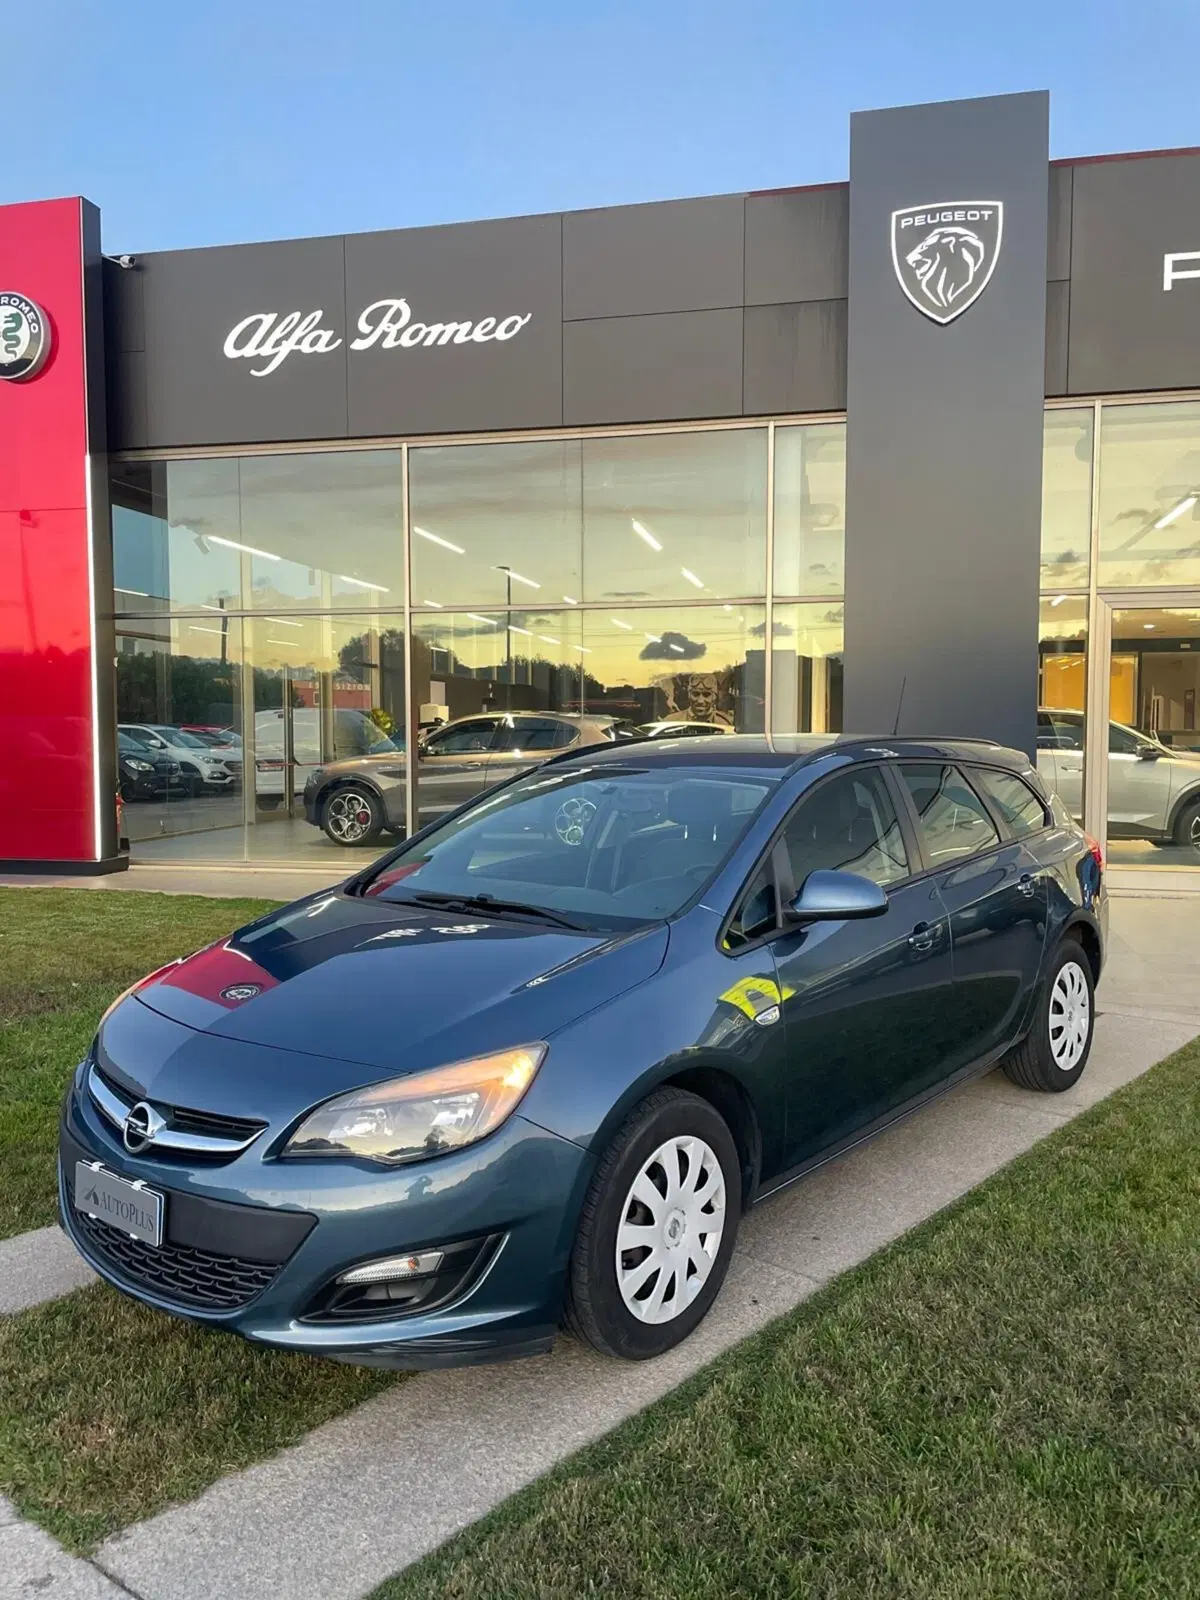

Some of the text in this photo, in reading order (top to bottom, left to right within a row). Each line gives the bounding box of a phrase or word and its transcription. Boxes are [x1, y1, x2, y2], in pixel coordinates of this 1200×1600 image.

[901, 210, 993, 229] PEUGEOT
[0, 296, 39, 333] ROMEO
[223, 298, 532, 377] Alfa Romeo
